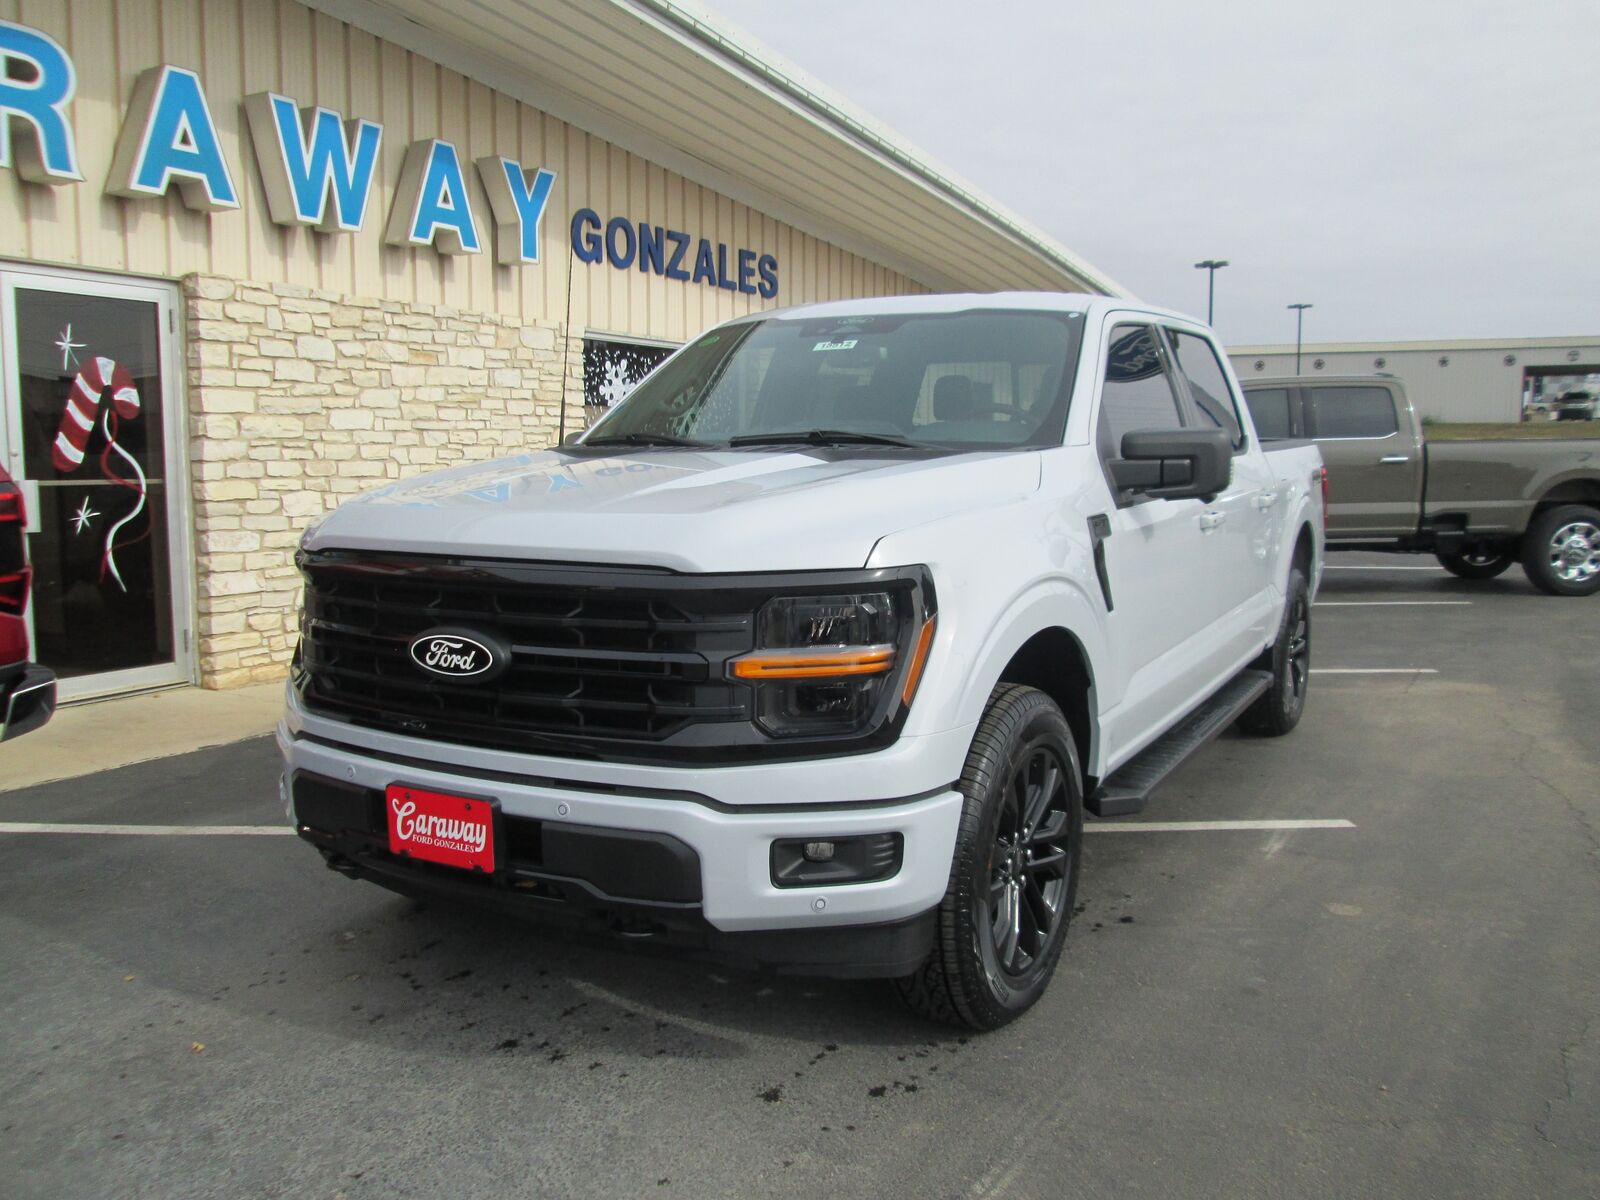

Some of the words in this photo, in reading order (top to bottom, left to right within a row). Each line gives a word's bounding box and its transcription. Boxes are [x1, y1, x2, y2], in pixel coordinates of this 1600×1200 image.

[571, 208, 779, 299] GONZALES
[426, 640, 476, 670] Ford
[392, 799, 487, 852] Caraway
[412, 834, 433, 846] FORD
[433, 839, 475, 853] GONZALES
